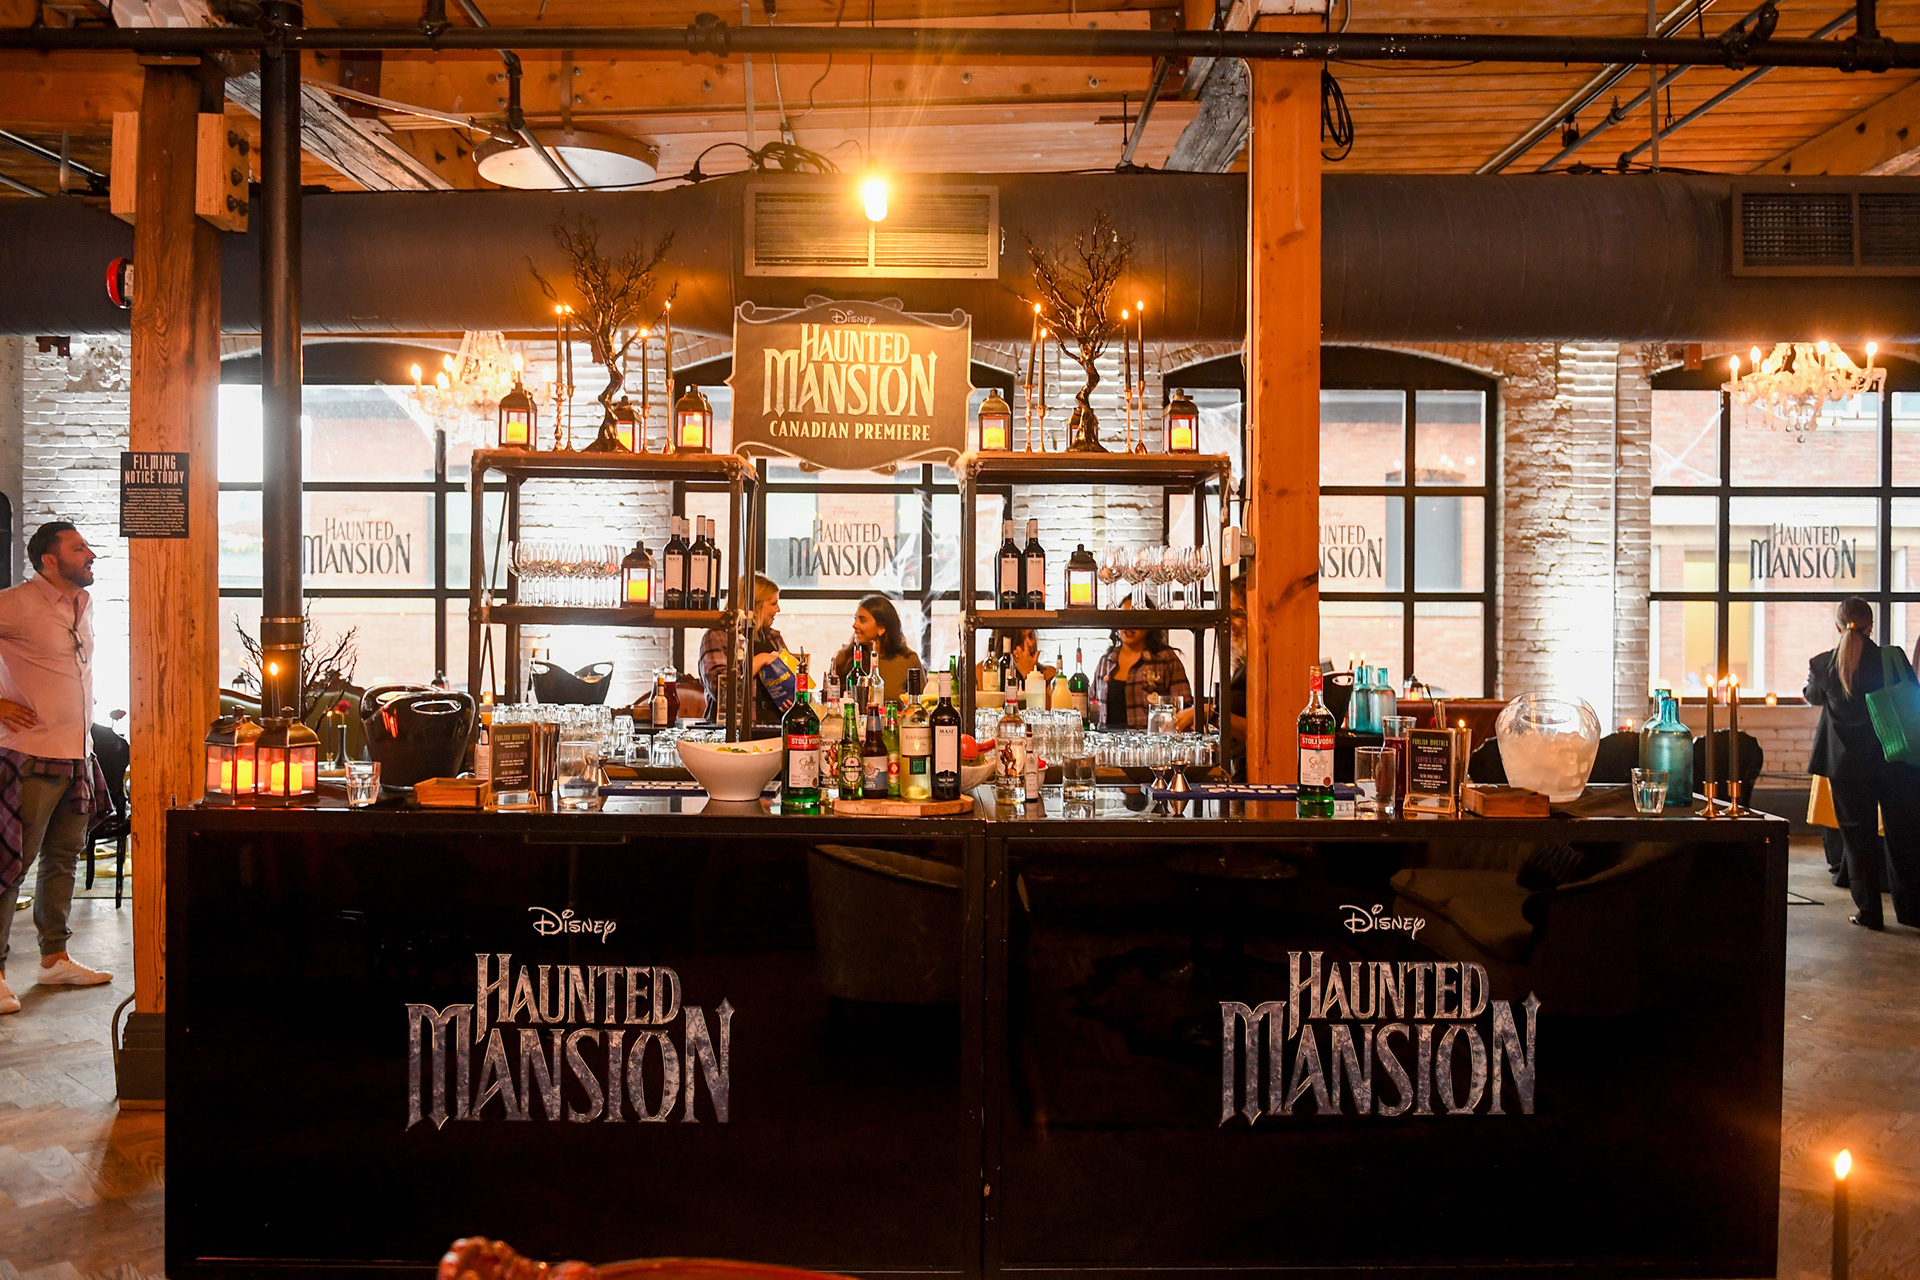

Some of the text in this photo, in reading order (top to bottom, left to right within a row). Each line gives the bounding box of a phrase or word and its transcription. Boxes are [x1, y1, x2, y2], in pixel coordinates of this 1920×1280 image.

[800, 323, 910, 372] HAUNTED
[762, 349, 939, 418] MANSION
[769, 420, 931, 441] CANADIAN PREMIERE
[124, 470, 184, 484] NOTICE TODAY
[133, 454, 176, 471] FILMING
[325, 517, 394, 545] HAUNTED
[812, 519, 881, 544] HAUNTED
[1318, 525, 1366, 545] UNTED
[1773, 523, 1840, 550] HAUNTED
[302, 533, 411, 575] MANSION
[788, 534, 899, 579] MANSION
[1750, 537, 1857, 580] MANSION
[1302, 737, 1318, 745] STOLI
[475, 953, 682, 1045] HAUNTED
[1287, 951, 1490, 1041] HAUNTED
[404, 997, 735, 1131] MANSION
[1218, 990, 1542, 1128] MANSION
